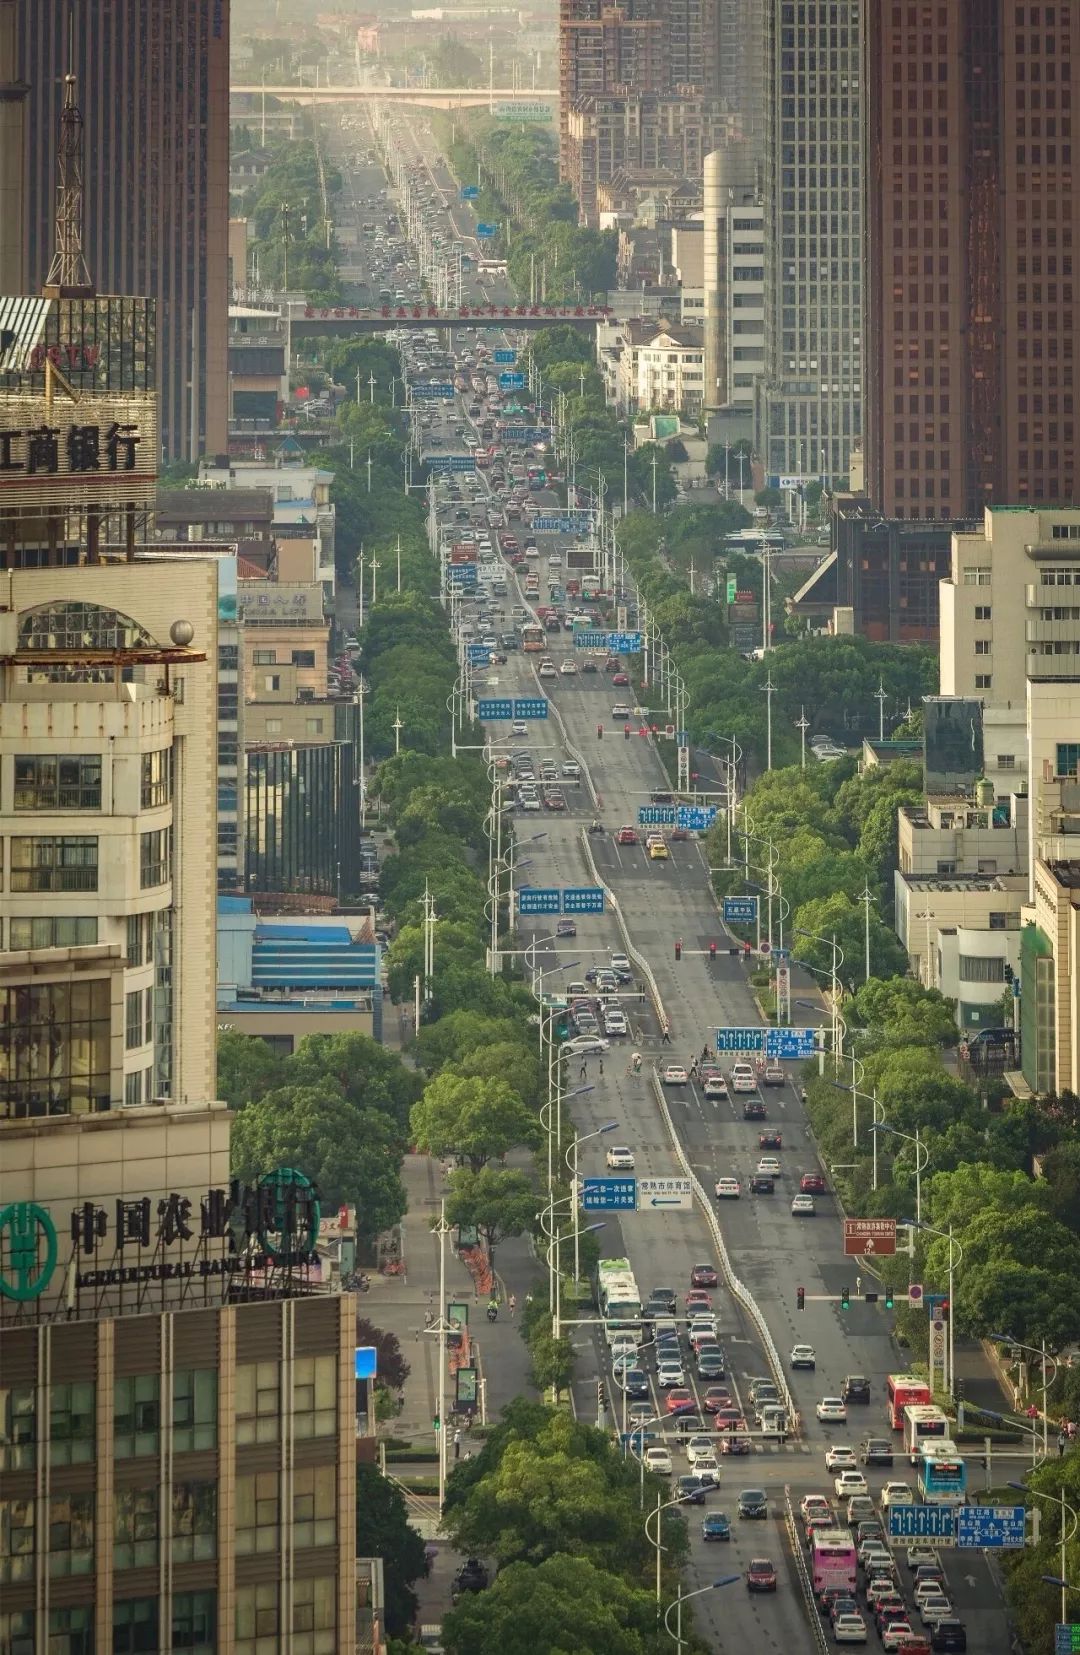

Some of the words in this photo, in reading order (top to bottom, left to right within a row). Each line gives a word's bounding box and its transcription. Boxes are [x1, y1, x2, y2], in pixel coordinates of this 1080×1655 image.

[240, 594, 307, 606] 中国人寿
[217, 1023, 236, 1031] KFC
[640, 1181, 691, 1190] 常熟市体育馆
[75, 1261, 195, 1288] AGRICULTURAL
[200, 1257, 242, 1276] BANK
